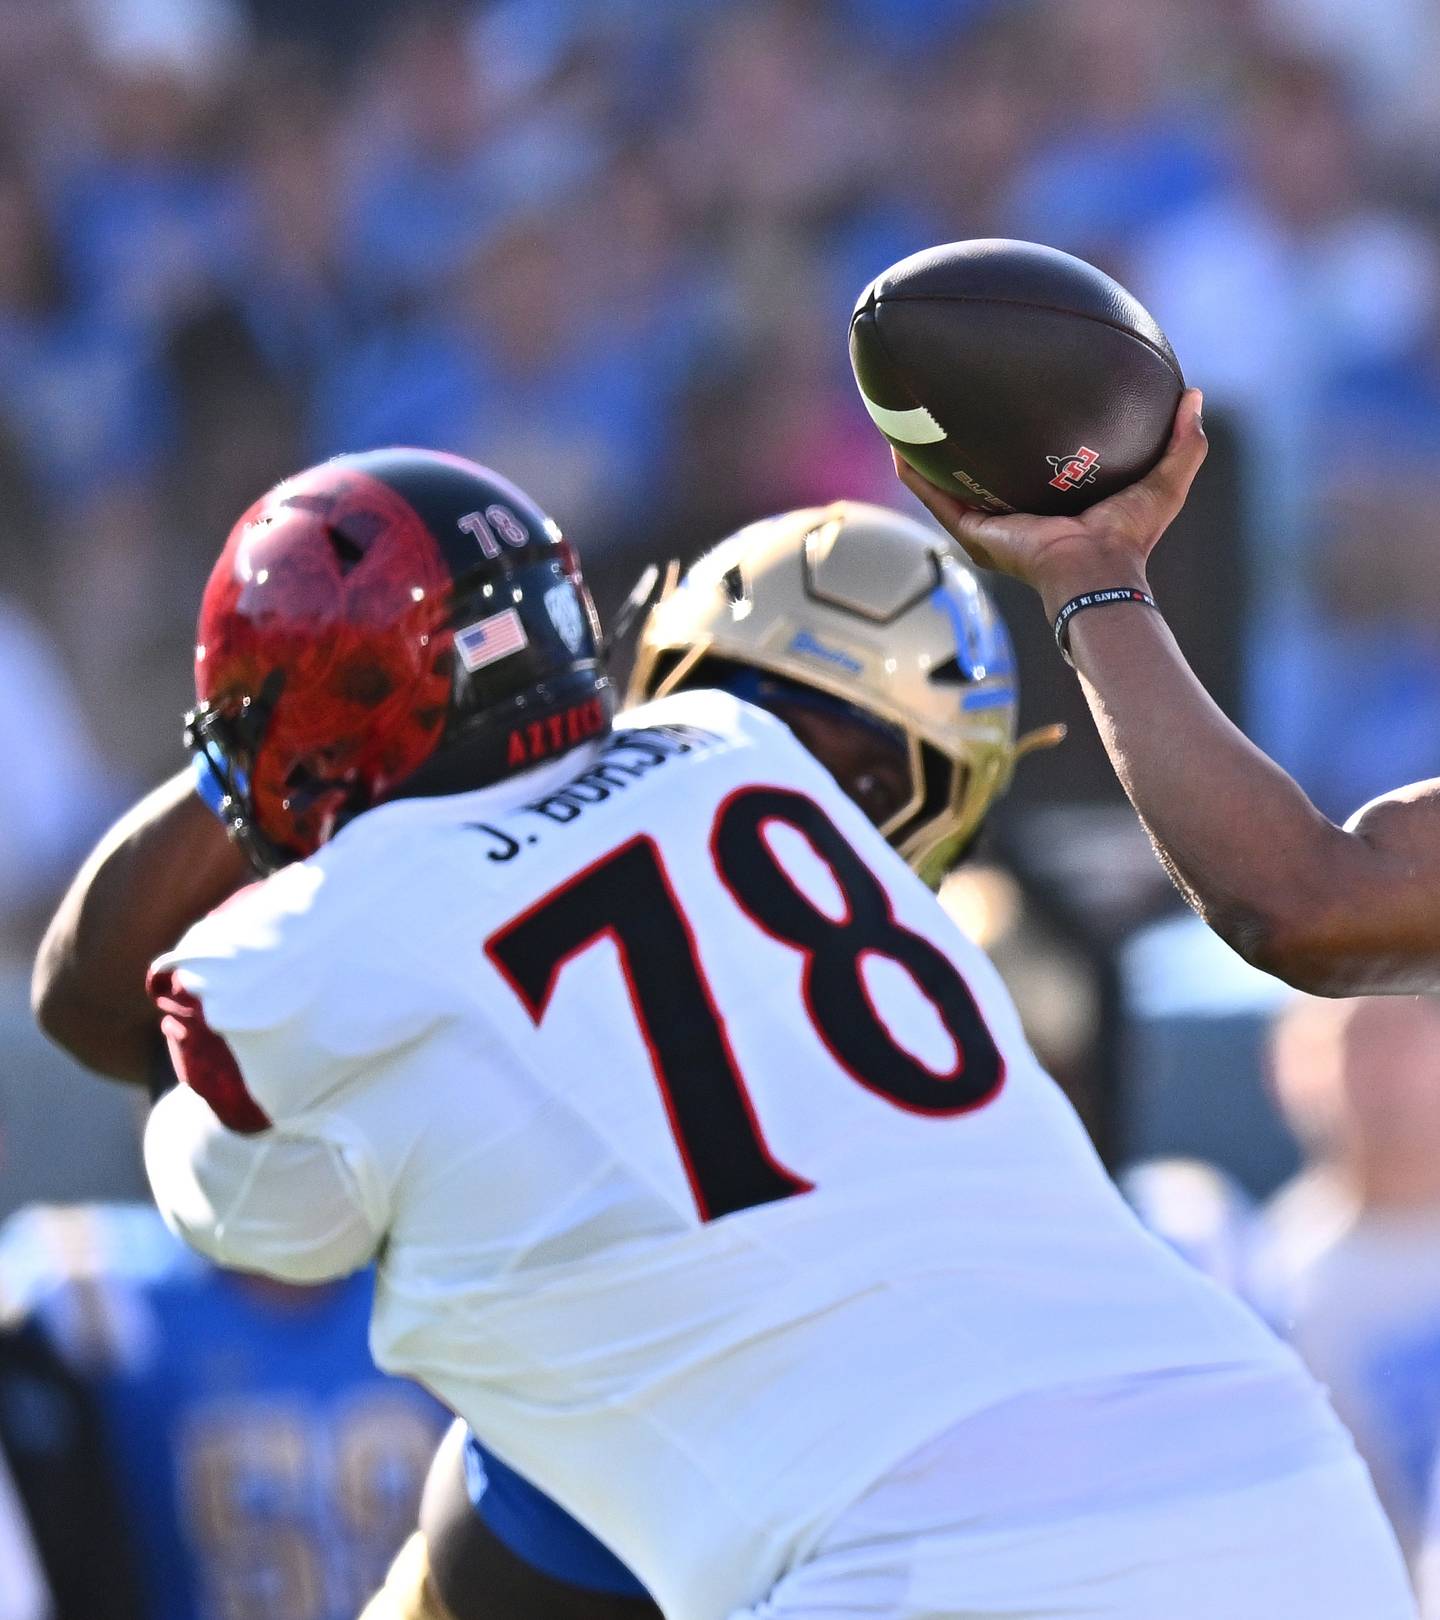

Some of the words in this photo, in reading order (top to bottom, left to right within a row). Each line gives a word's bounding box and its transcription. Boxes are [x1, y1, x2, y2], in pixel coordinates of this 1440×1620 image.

[457, 504, 530, 559] 78
[1080, 598, 1092, 606] IN
[1095, 590, 1131, 602] ALWAYS
[1062, 602, 1078, 618] THE
[484, 784, 1007, 1223] 78
